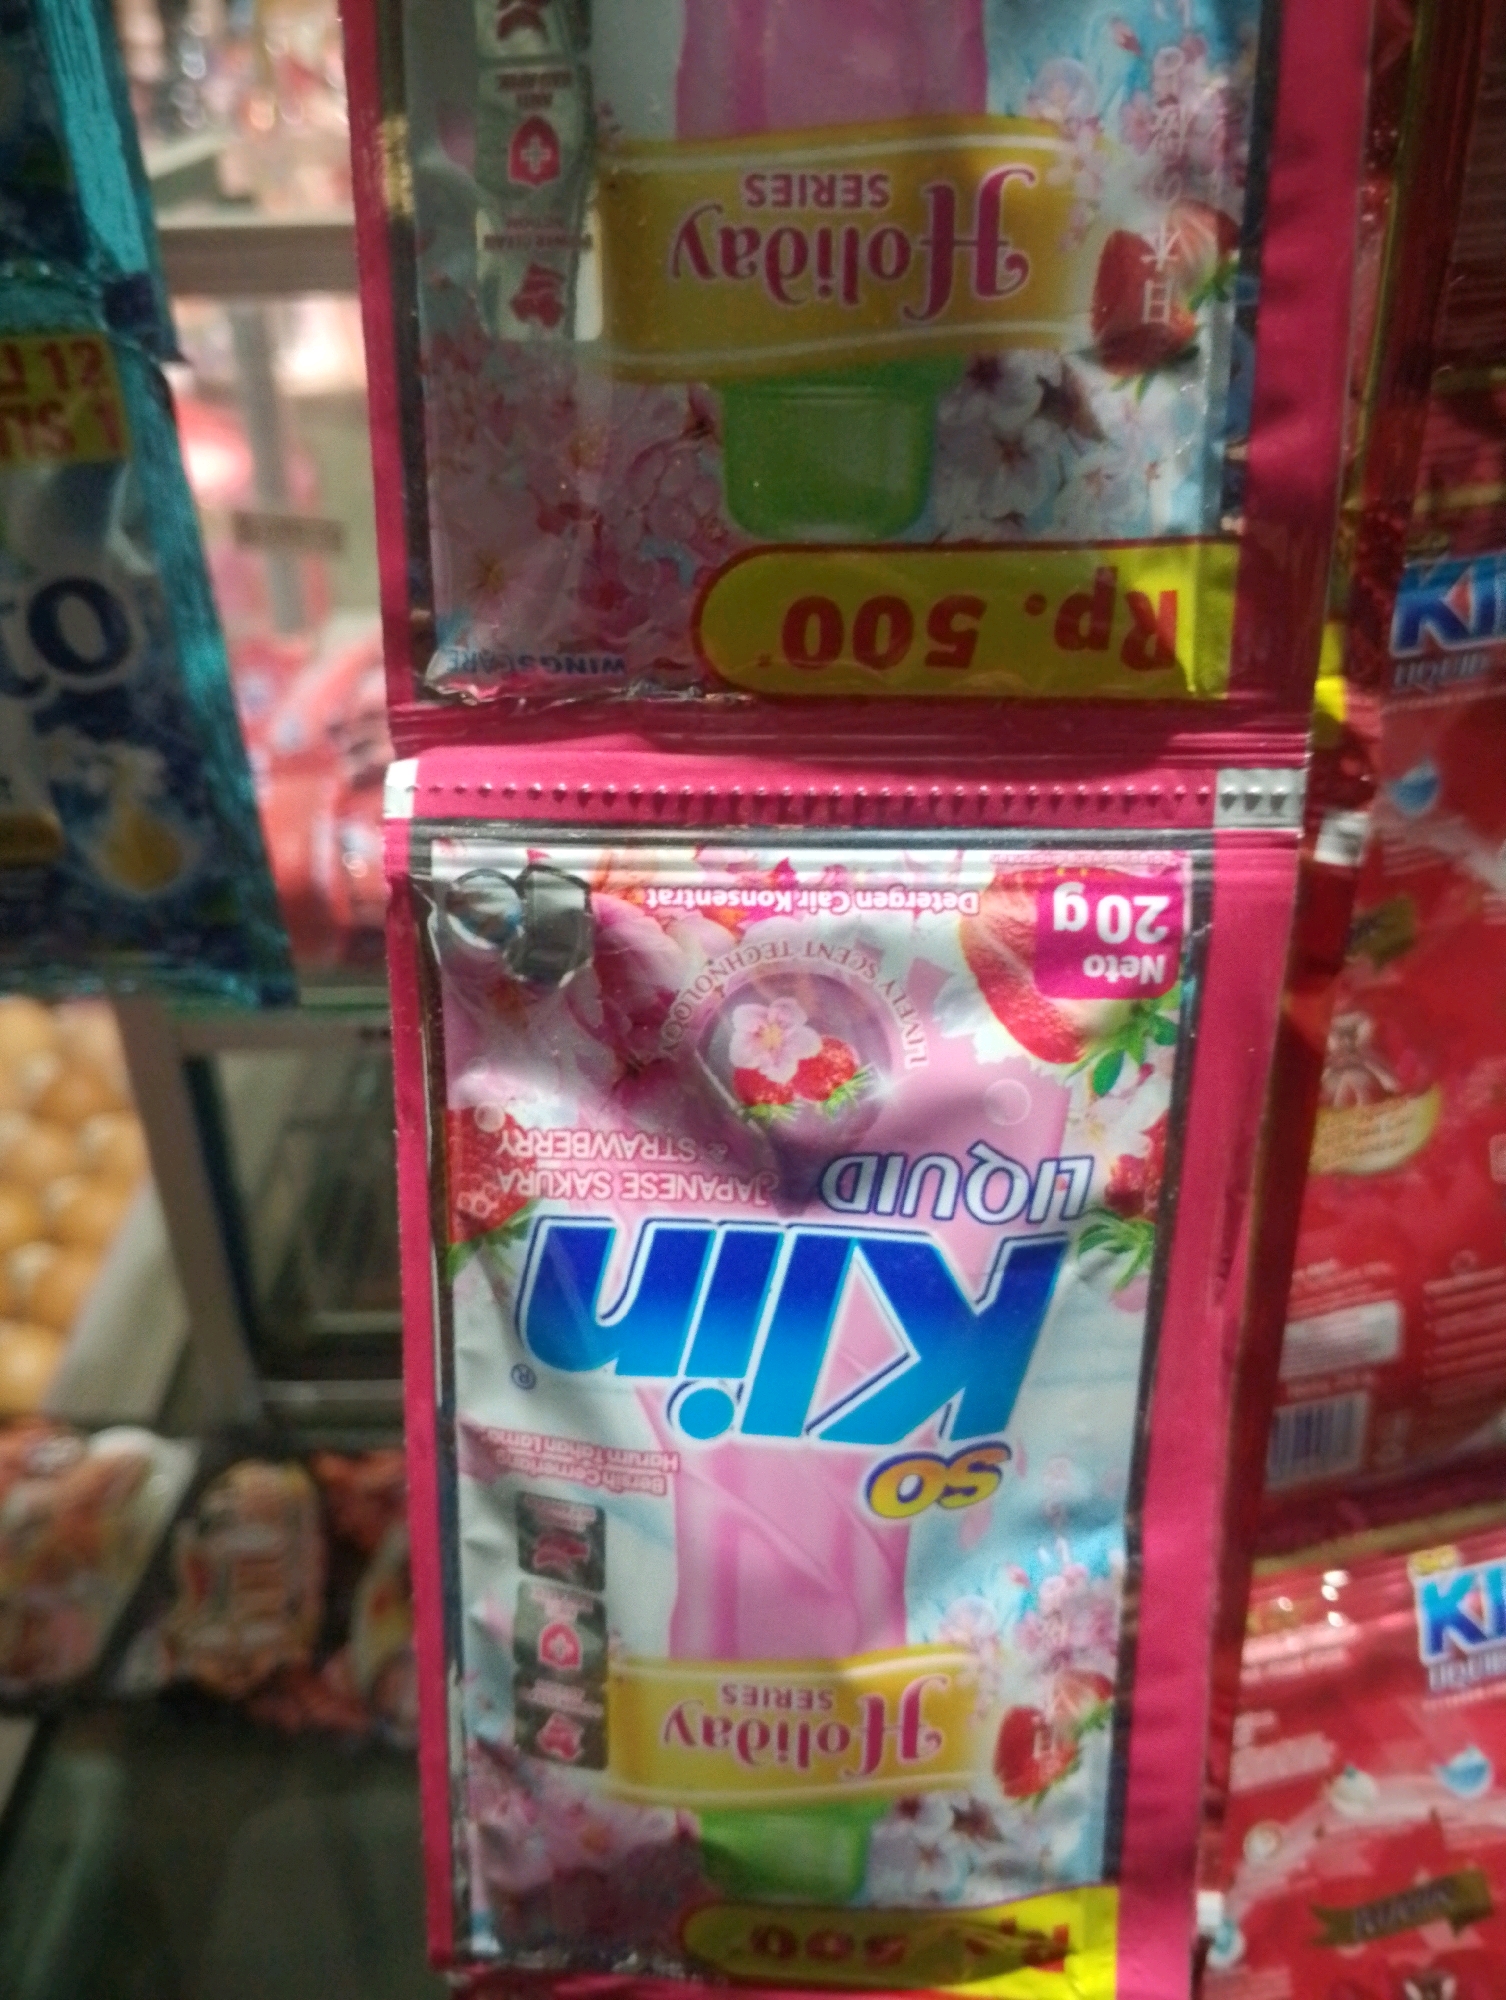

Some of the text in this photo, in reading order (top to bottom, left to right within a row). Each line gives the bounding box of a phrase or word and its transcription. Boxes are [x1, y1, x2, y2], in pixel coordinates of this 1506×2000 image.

[743, 173, 891, 211] SERIES
[668, 163, 1038, 322] Holiday
[1023, 568, 1178, 670] Rp.
[646, 887, 792, 914] Konsentrat
[855, 886, 978, 914] Detergen
[1082, 954, 1165, 985] Neto
[661, 939, 929, 1070] LIVELY SCENT TECHNOLOG
[495, 1128, 697, 1163] STRAWBERRY
[496, 1169, 779, 1206] JAPANESE SAKURA
[820, 1140, 1095, 1223] LIQUID
[513, 1216, 1070, 1448] Klin
[720, 1681, 835, 1712] SERIES
[663, 1673, 948, 1784] Holiday
